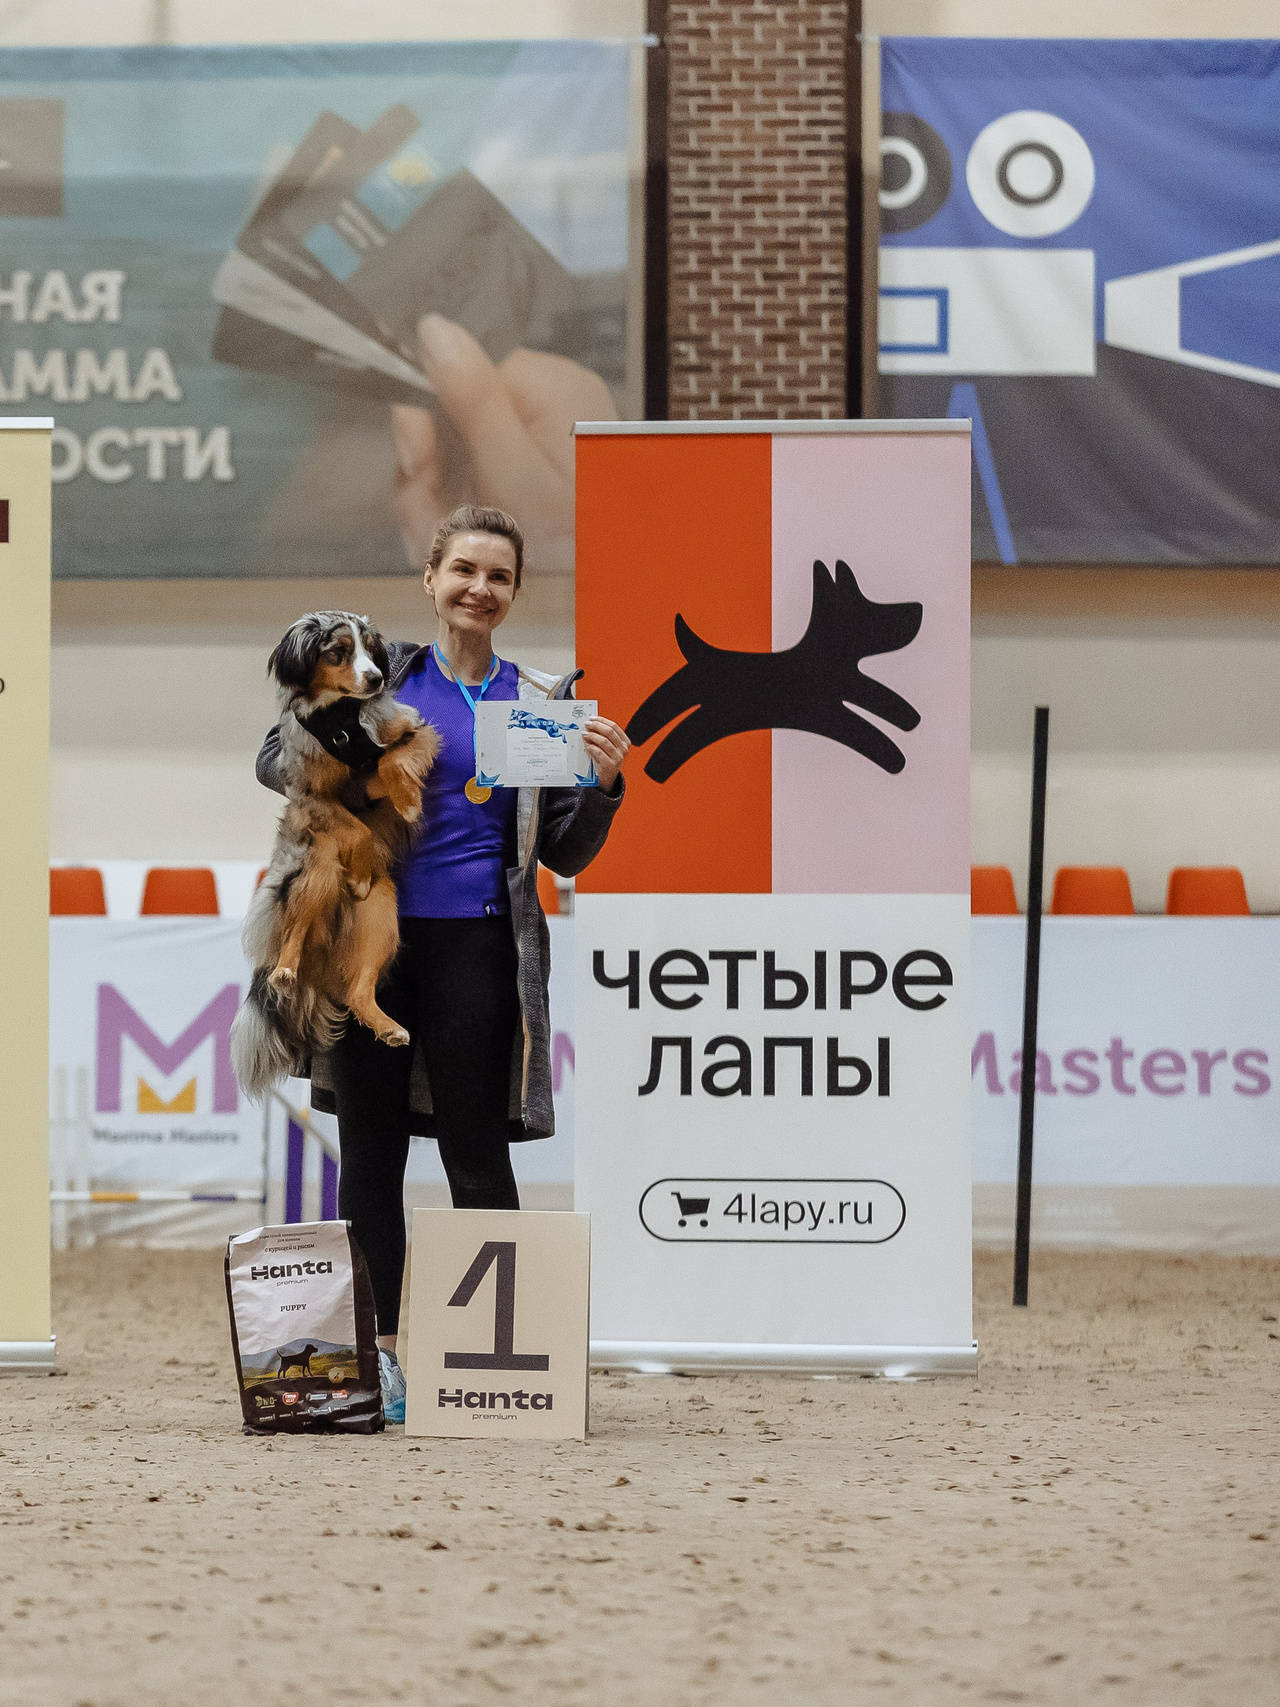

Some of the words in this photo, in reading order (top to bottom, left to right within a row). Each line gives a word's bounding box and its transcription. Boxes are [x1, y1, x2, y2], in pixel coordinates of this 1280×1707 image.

[51, 424, 236, 483] ОСТИ
[591, 947, 955, 1012] четыре
[637, 1034, 892, 1099] лапы
[722, 1192, 876, 1232] 4lapy.ru
[250, 1260, 333, 1281] Hanta
[280, 1303, 307, 1312] PUPPY
[443, 1240, 550, 1371] 1
[437, 1388, 554, 1411] Hanta
[471, 1412, 518, 1421] premium
